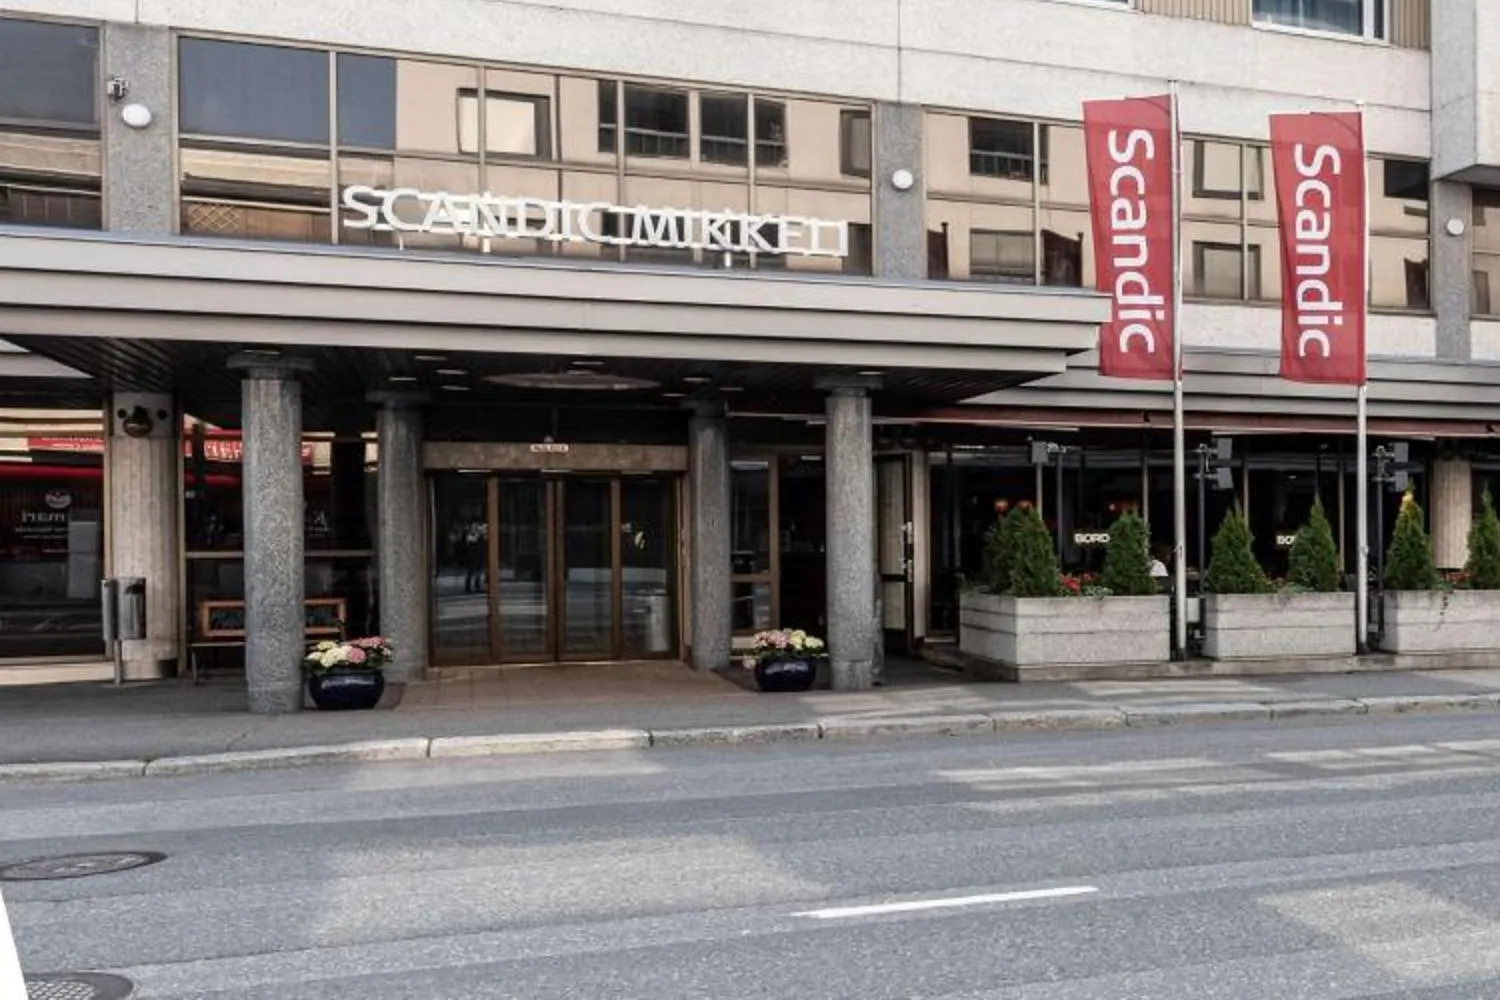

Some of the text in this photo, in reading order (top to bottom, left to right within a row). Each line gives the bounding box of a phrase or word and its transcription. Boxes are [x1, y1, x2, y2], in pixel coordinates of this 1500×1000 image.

[343, 184, 849, 257] SCANDIC MIKKELI
[1107, 128, 1165, 354] Scandic
[1293, 143, 1344, 358] Scandic
